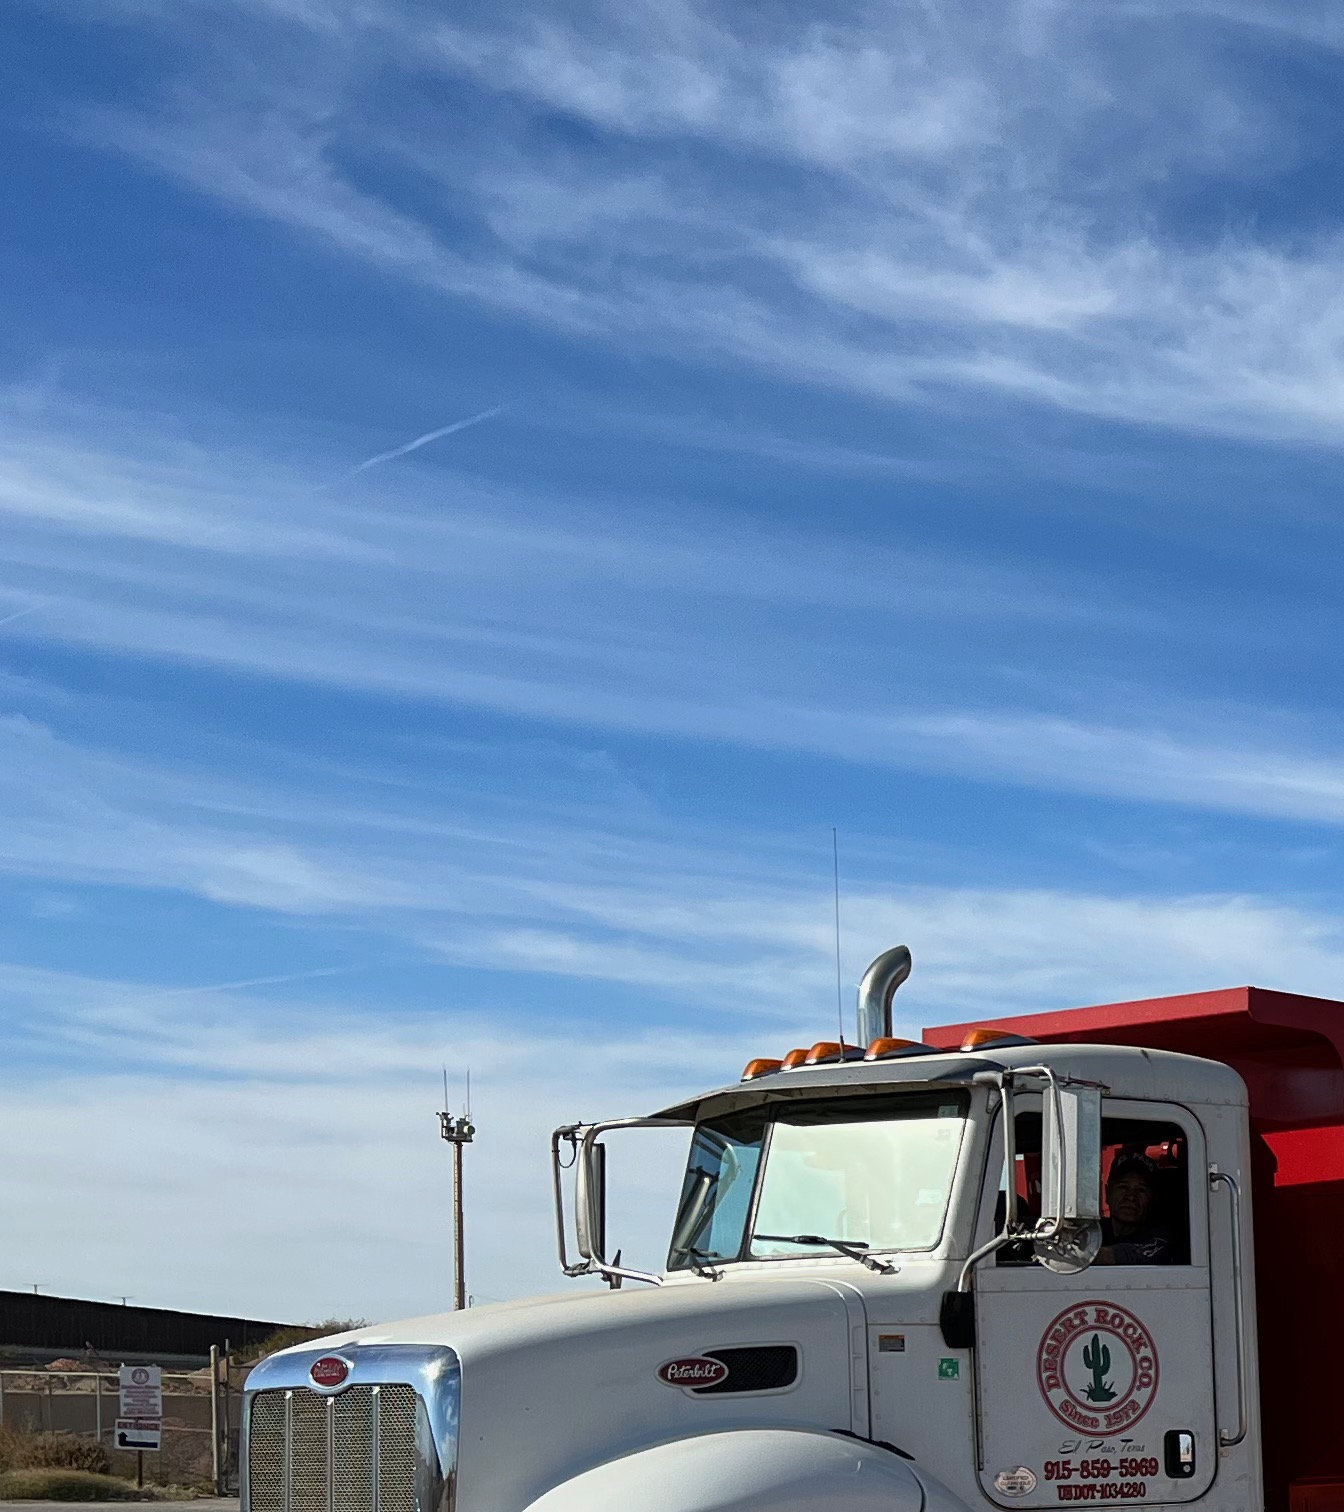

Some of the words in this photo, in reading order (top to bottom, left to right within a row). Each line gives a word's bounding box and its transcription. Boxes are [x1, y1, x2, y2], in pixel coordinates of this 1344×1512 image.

[1043, 1308, 1088, 1392] DESERT
[1094, 1307, 1148, 1354] ROCK
[667, 1363, 720, 1380] Peterbilt
[1059, 1399, 1100, 1429] Since
[1104, 1399, 1141, 1429] 1972
[1058, 1440, 1082, 1455] El
[1120, 1439, 1145, 1453] Texas
[1044, 1457, 1159, 1480] 915-859-5969
